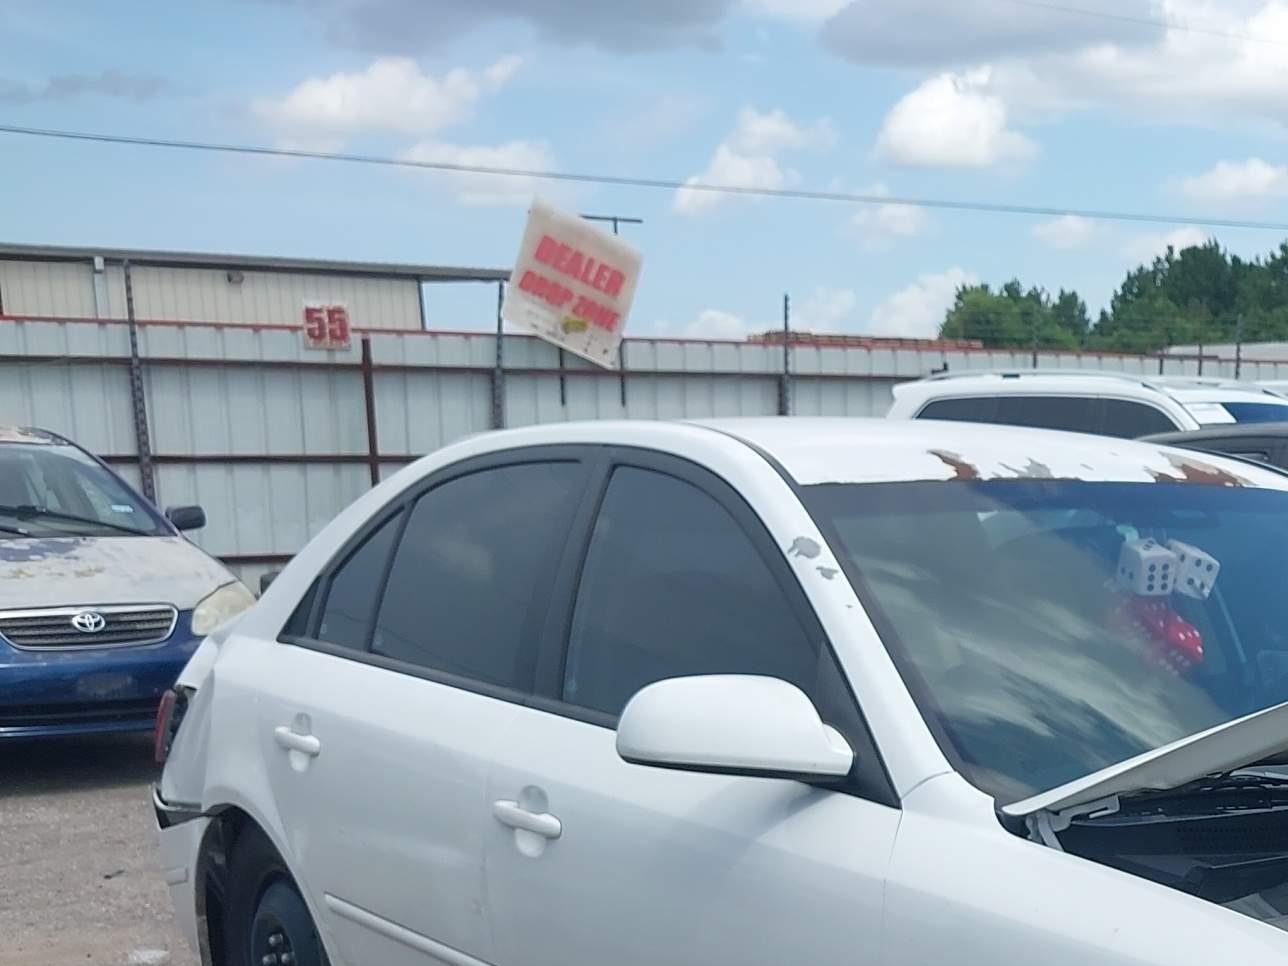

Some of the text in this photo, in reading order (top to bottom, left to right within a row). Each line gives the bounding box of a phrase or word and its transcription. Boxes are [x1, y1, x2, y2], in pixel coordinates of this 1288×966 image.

[533, 234, 627, 299] DEALER
[305, 307, 349, 343] 55
[519, 270, 621, 333] DROP ZONE
